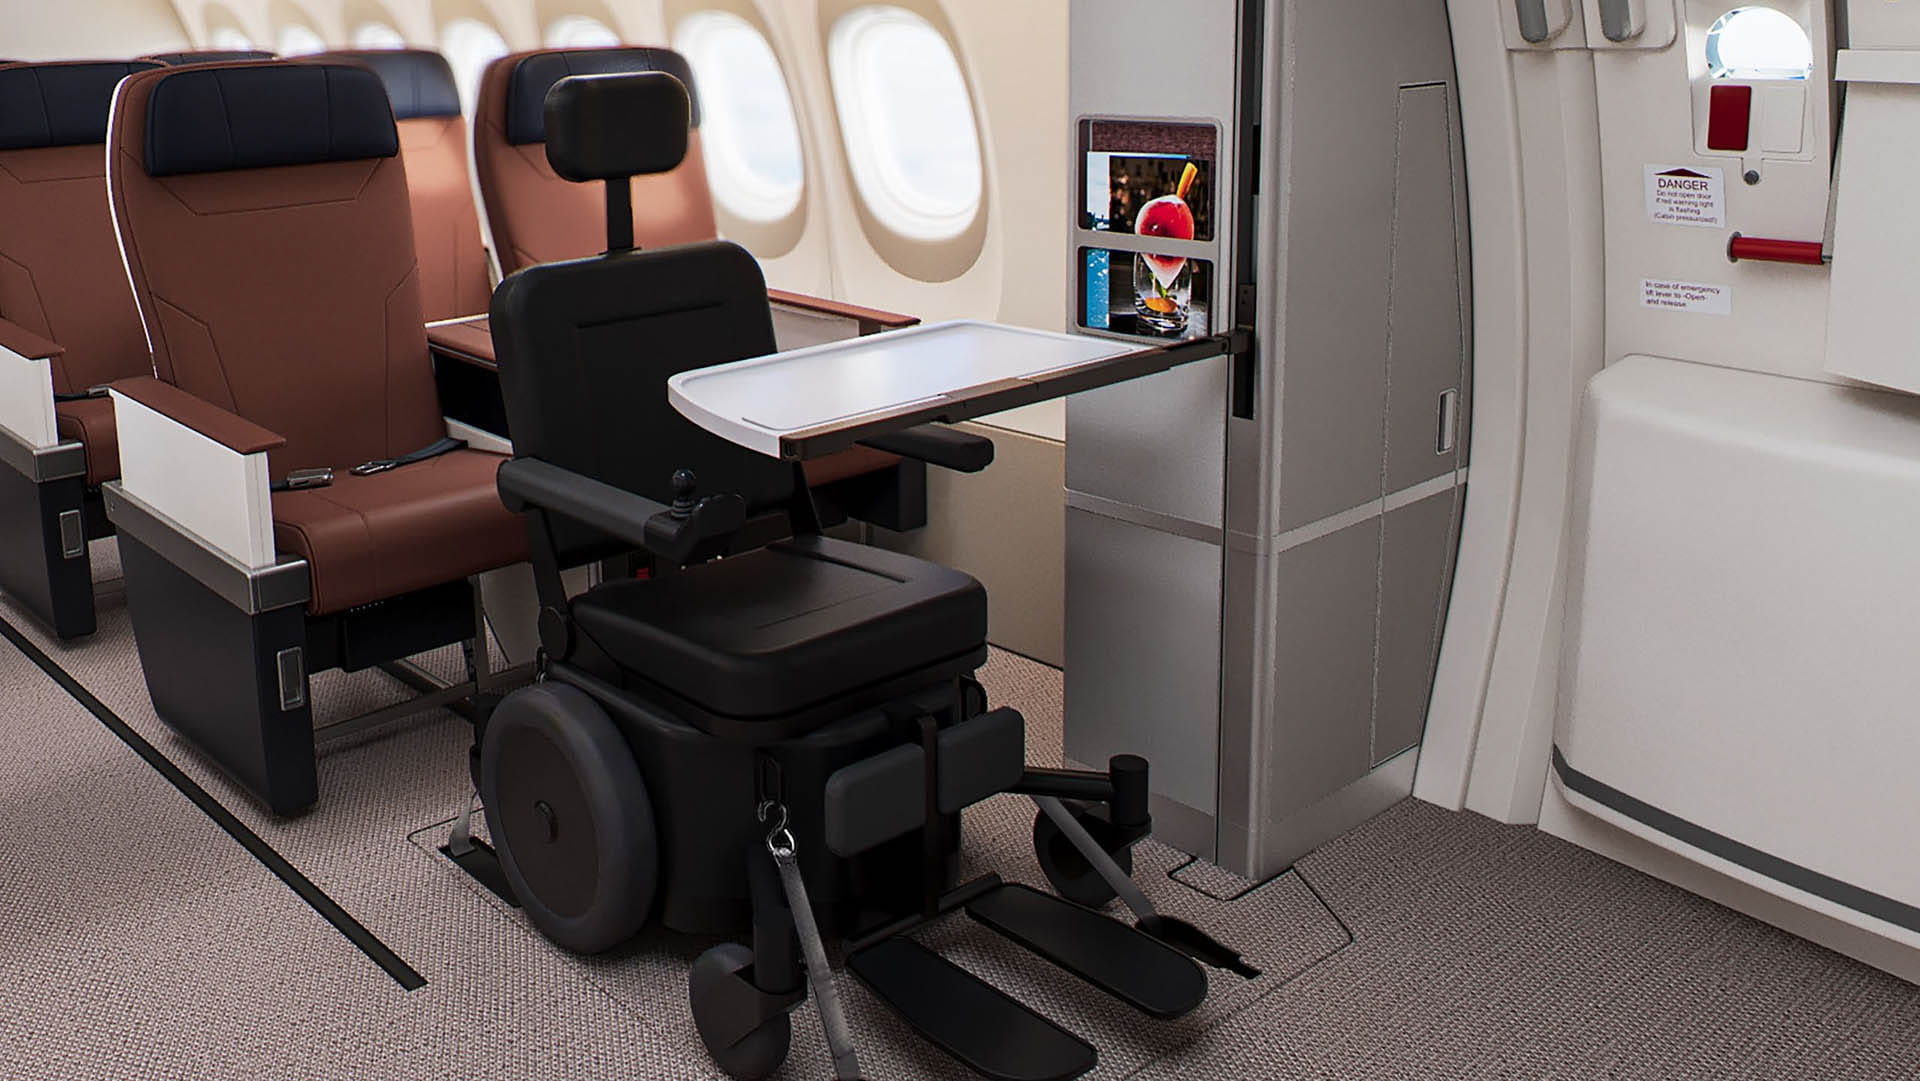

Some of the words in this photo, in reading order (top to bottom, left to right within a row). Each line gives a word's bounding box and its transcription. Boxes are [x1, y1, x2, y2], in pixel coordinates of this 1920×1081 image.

[1658, 178, 1709, 191] DANGER
[1673, 200, 1698, 208] warning
[1675, 207, 1700, 215] flashing
[1680, 285, 1720, 295] emergency
[1660, 299, 1686, 307] release
